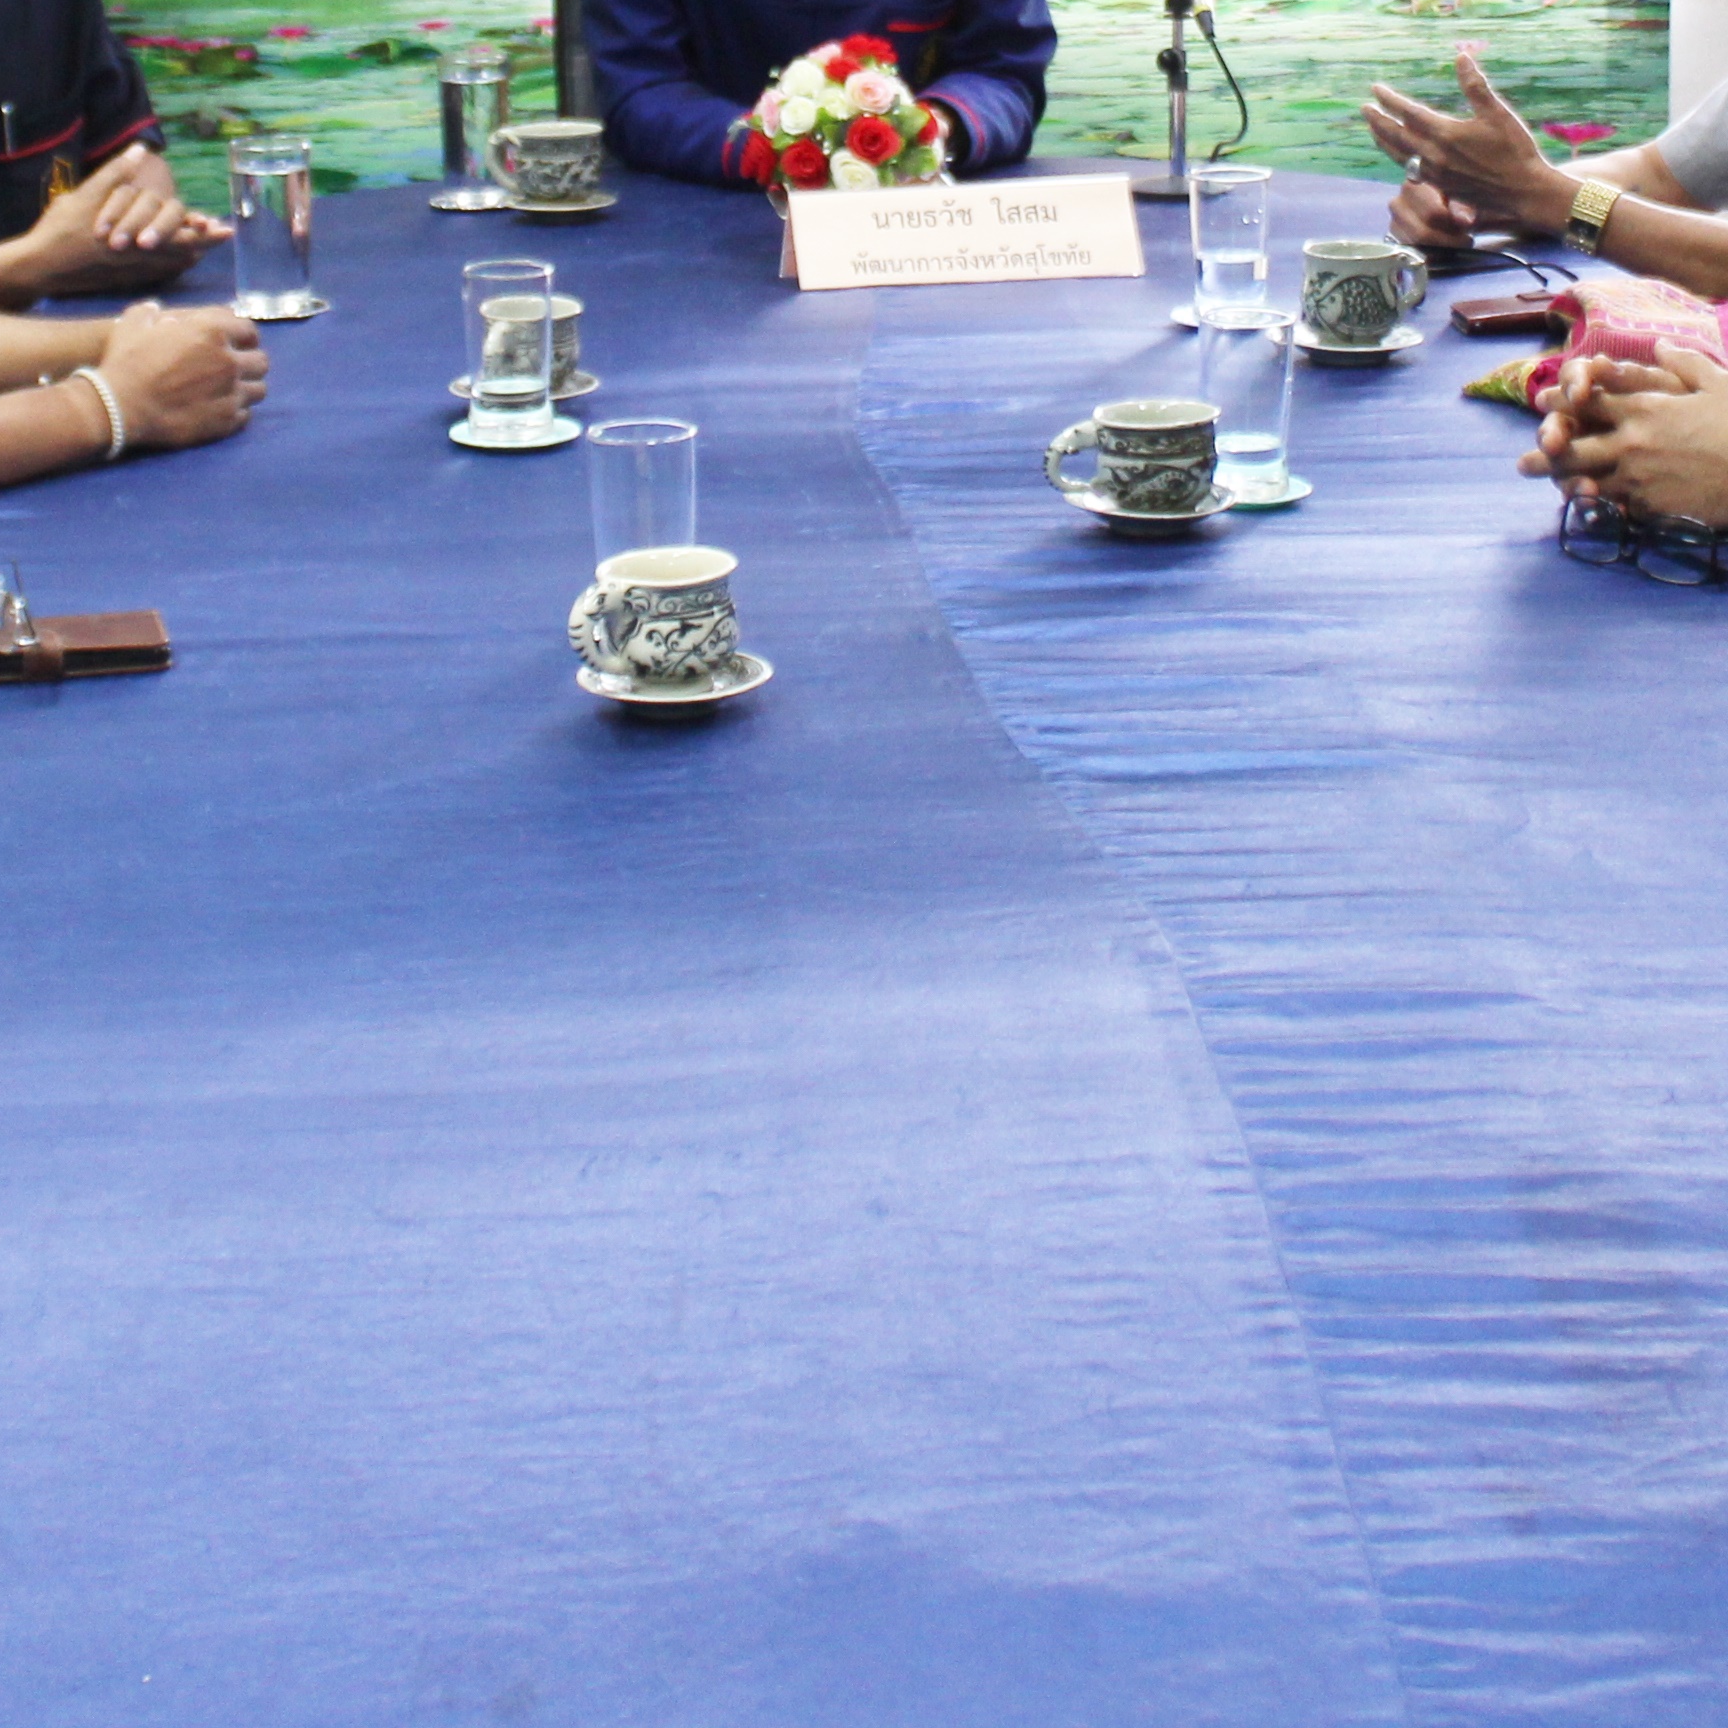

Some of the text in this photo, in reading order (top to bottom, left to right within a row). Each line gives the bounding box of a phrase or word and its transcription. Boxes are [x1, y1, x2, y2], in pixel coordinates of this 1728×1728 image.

[873, 200, 972, 229] นายธวัช
[851, 245, 1091, 274] พัฒนาการจังหวัดสุโขทัย
